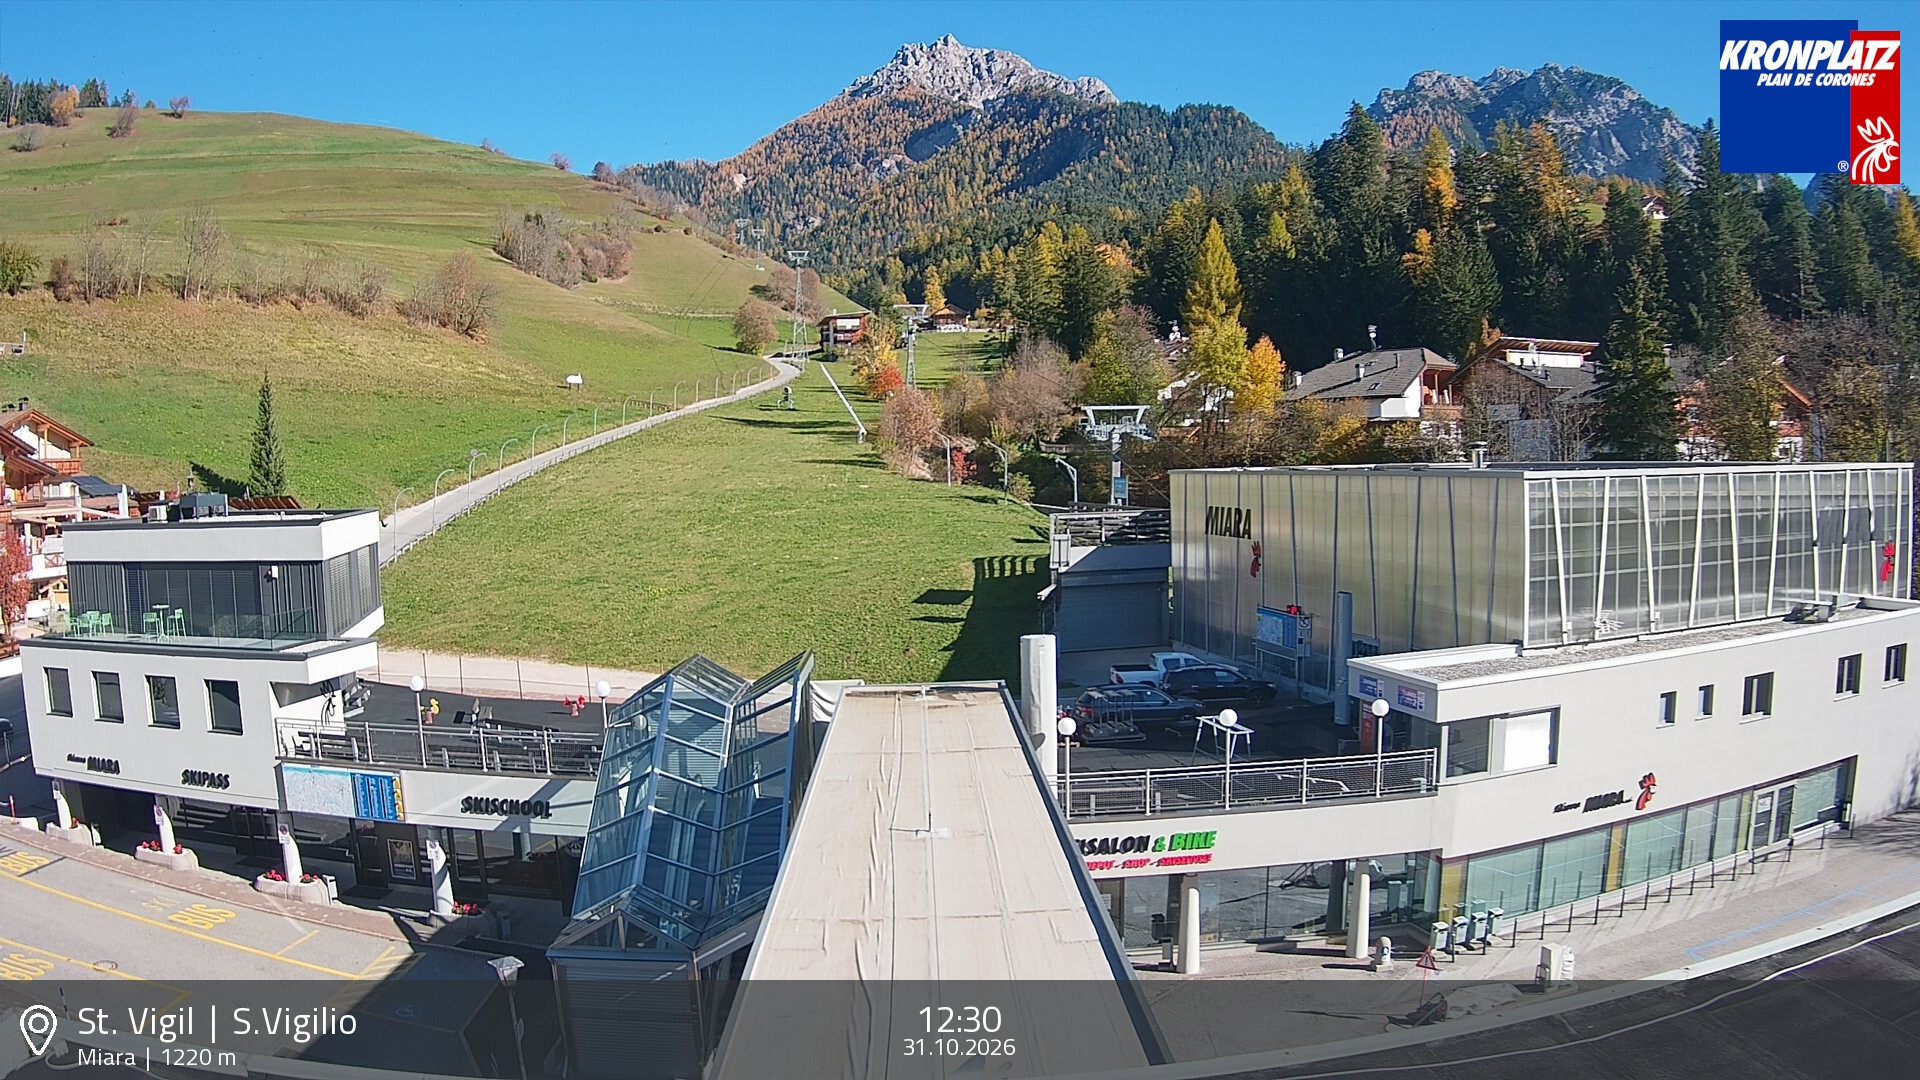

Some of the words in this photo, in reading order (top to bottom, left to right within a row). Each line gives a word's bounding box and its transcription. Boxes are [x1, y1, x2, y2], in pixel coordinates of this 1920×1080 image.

[1205, 505, 1252, 540] MIARA
[87, 756, 121, 775] MIARA
[181, 769, 231, 790] SKIPASS
[460, 795, 553, 819] SKISCHOOL
[1075, 834, 1151, 856] ISALON
[1151, 835, 1167, 853] &
[1168, 830, 1218, 852] BIKE
[0, 851, 49, 873] BUS
[1121, 858, 1150, 869] SHOP
[168, 903, 237, 930] BUS
